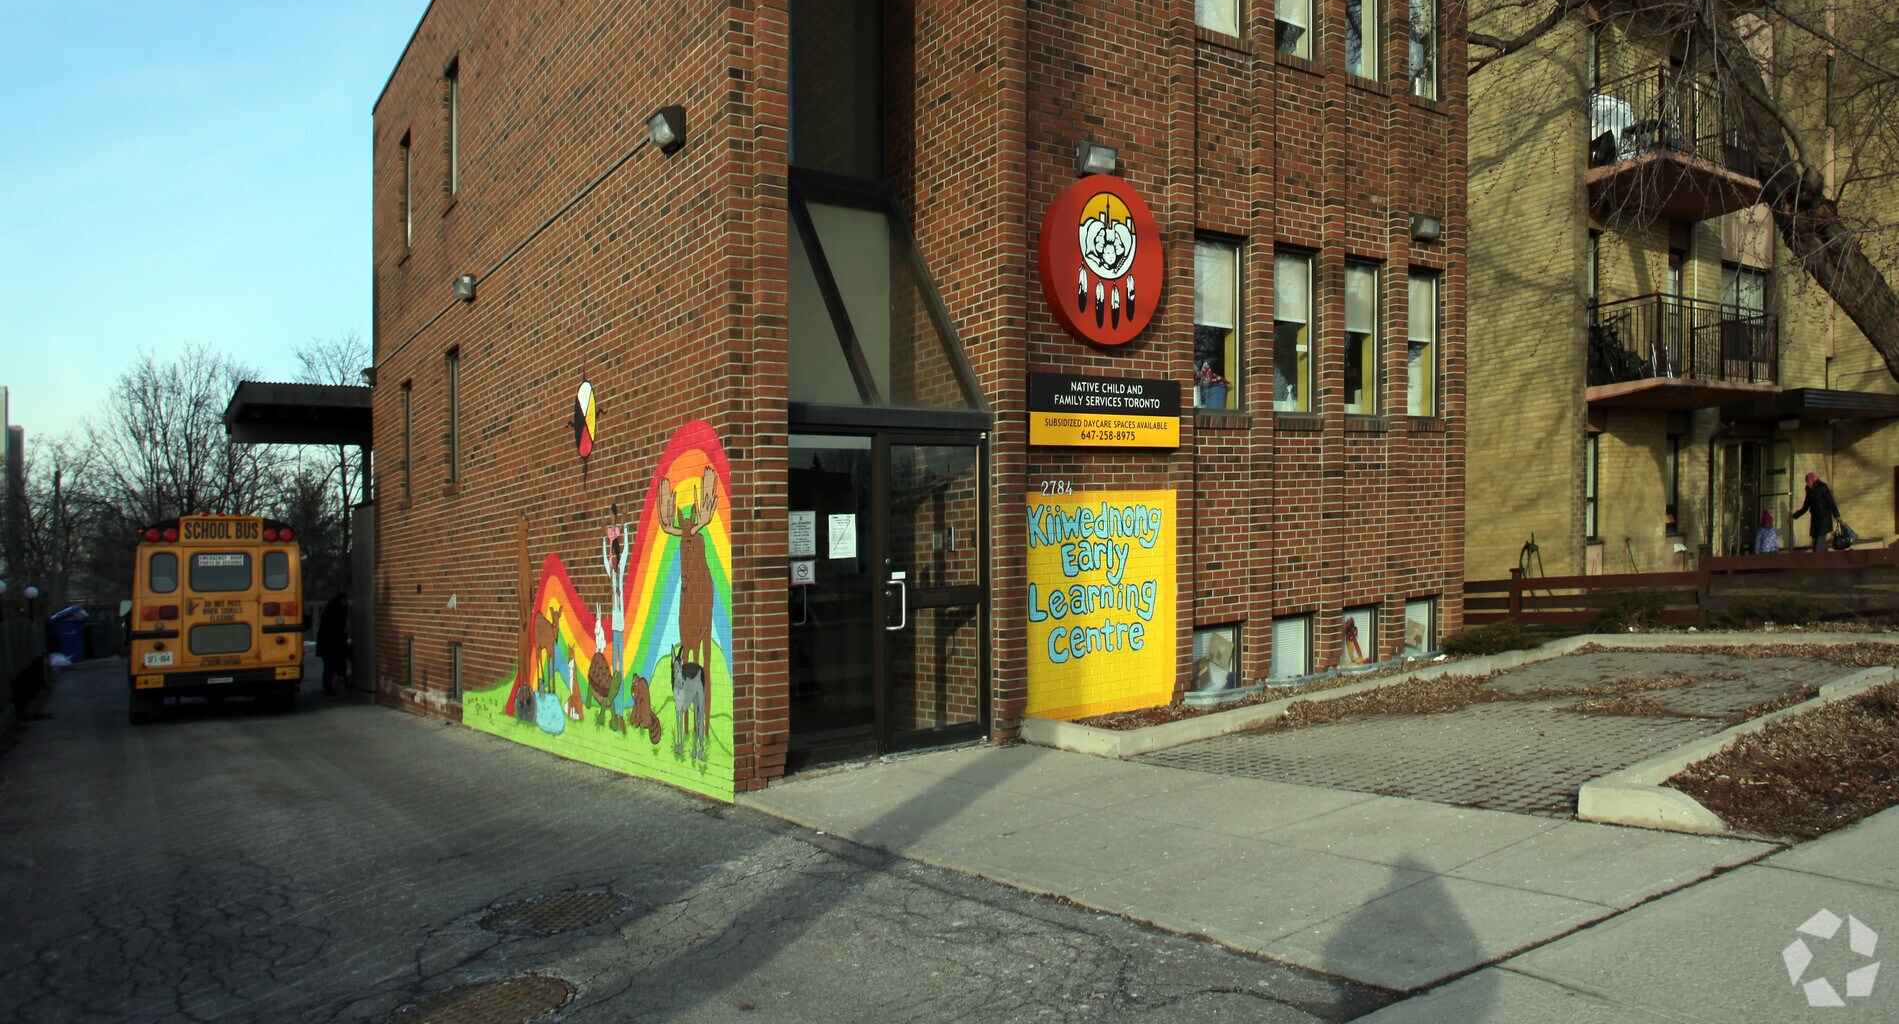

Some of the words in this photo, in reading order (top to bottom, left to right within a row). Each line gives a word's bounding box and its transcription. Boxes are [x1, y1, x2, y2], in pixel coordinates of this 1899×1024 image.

[1071, 381, 1100, 393] NATIVE
[1102, 383, 1126, 394] CHILD
[1127, 384, 1143, 395] AND
[1054, 394, 1084, 406] FAMILY
[1085, 396, 1122, 407] SERVICES
[1123, 397, 1160, 409] TORONTO
[1044, 417, 1082, 428] SUBSIDIZED
[1083, 419, 1112, 429] DAYCARE
[1113, 421, 1136, 429] SPACES
[1136, 421, 1168, 430] AVAILABLE
[1081, 430, 1136, 441] 647-258-8975
[1041, 480, 1073, 496] 2784
[184, 522, 232, 540] SCHOOL
[235, 522, 259, 539] BUS
[1026, 502, 1162, 549] Kiiwednong
[1061, 538, 1129, 586] Early
[1027, 579, 1157, 623] Learning
